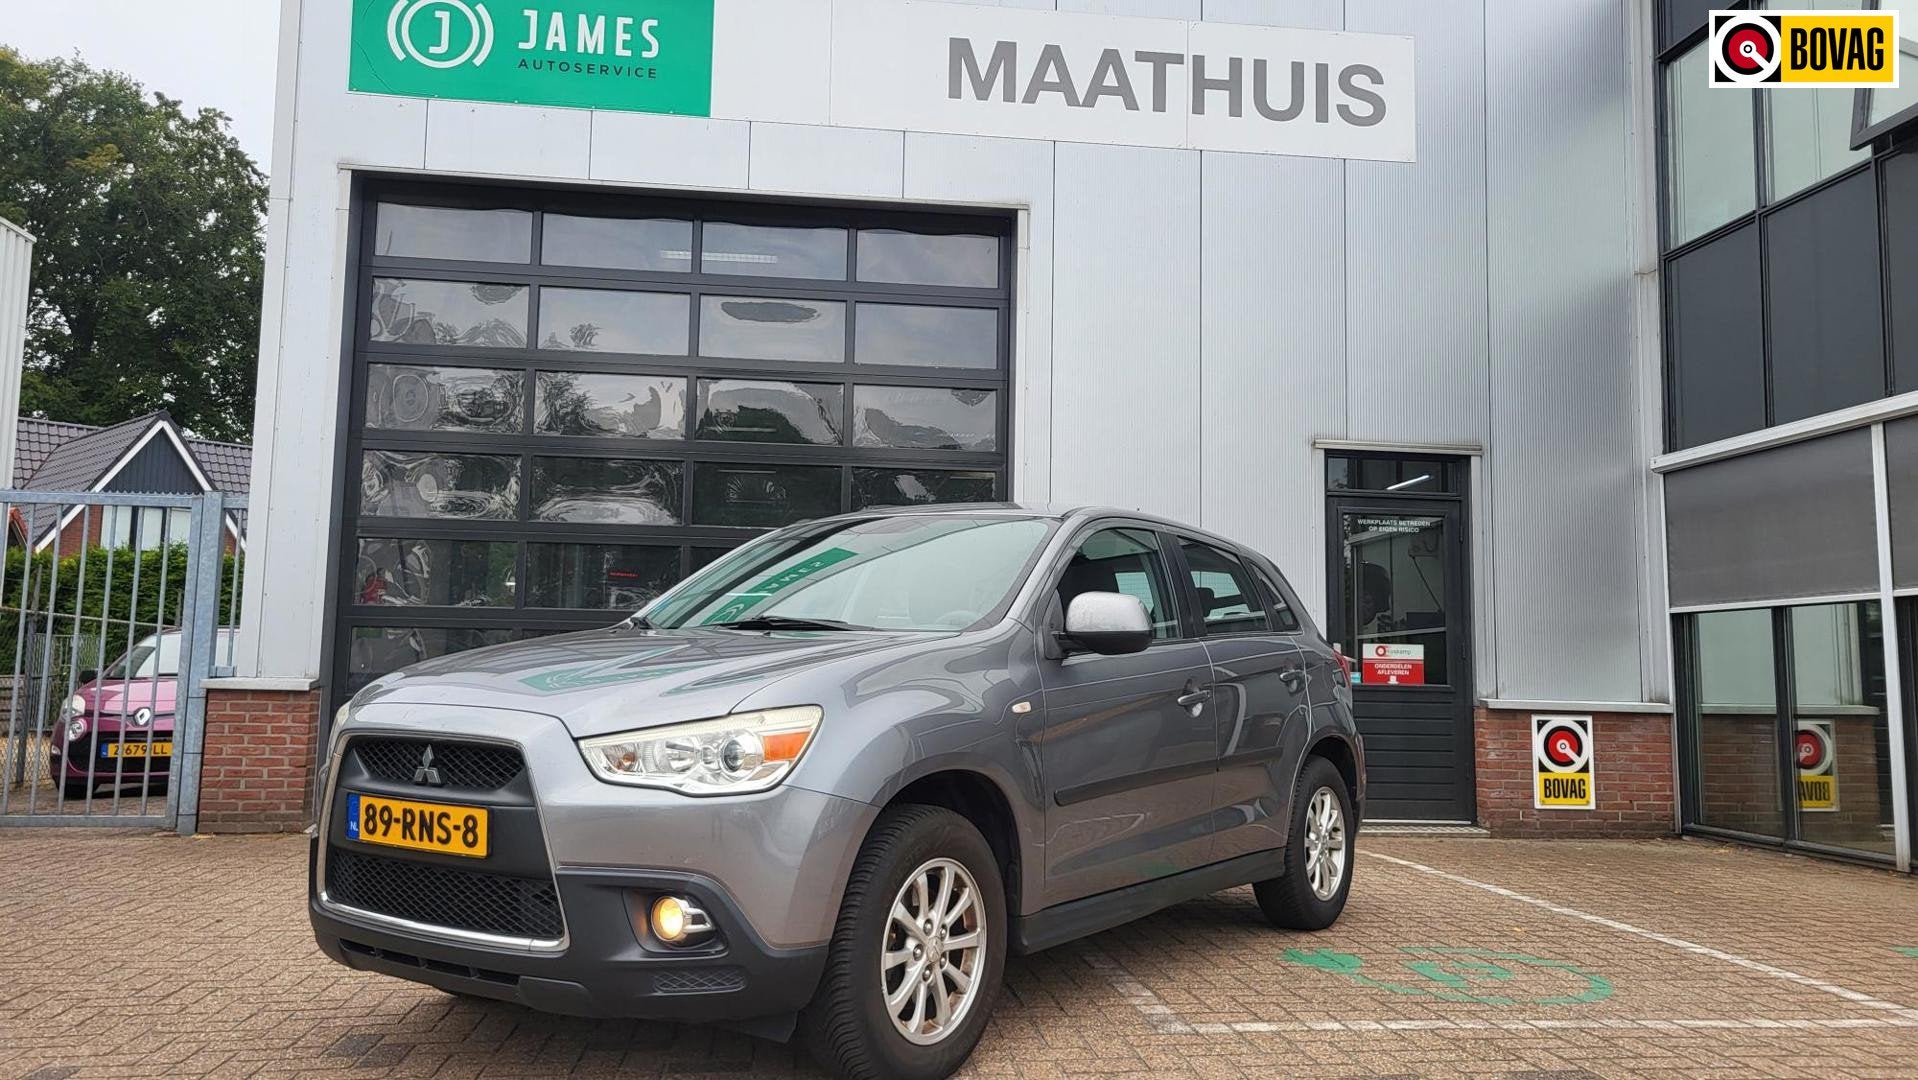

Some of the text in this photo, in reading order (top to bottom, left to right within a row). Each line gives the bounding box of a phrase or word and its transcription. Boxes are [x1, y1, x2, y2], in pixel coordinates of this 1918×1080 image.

[518, 9, 660, 59] JAMES
[518, 58, 658, 79] AUTOSERVICE
[947, 37, 1387, 127] MAATHUIS
[1543, 777, 1587, 800] BOVAG
[350, 803, 479, 849] NL 89-RNS-8
